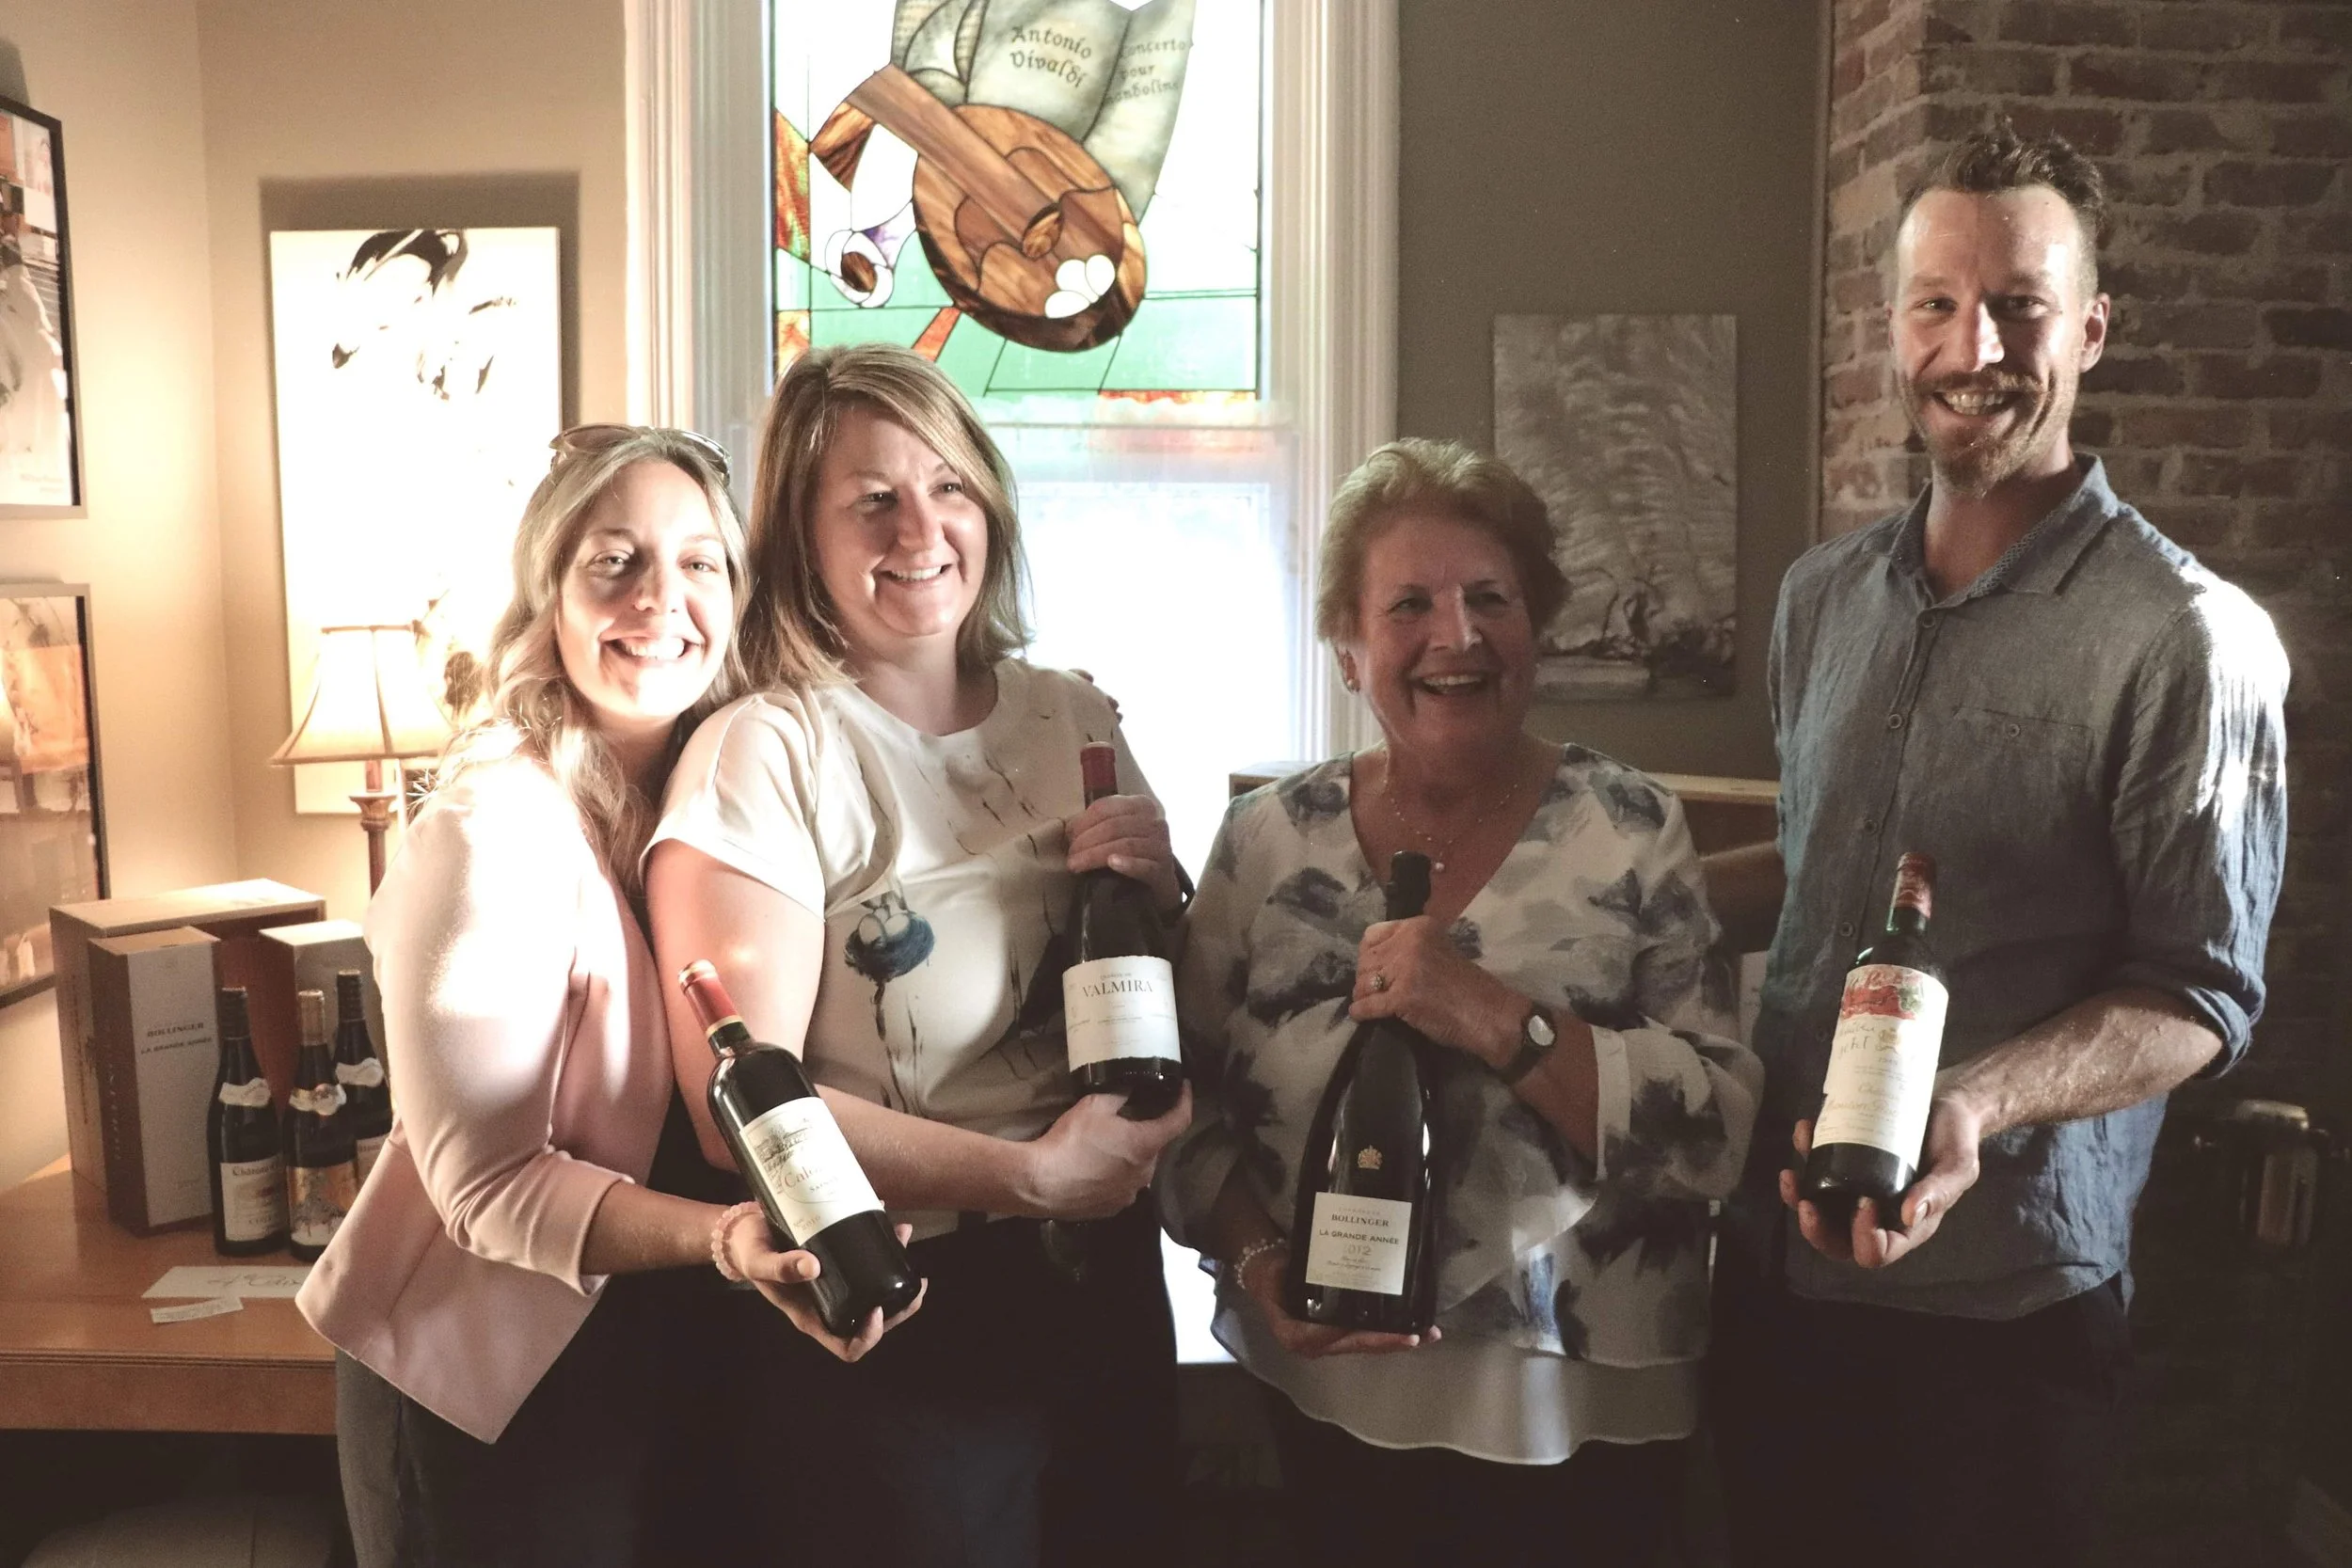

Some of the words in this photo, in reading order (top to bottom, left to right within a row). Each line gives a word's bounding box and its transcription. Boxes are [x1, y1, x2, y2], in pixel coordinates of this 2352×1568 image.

[1011, 25, 1091, 59] Antonio
[1009, 50, 1089, 88] Vivaldi
[1083, 979, 1153, 998] VALMIRA
[148, 1022, 203, 1037] BOLLINGER
[1331, 1213, 1390, 1227] BOLLINGER
[1331, 1230, 1367, 1242] GRANDE
